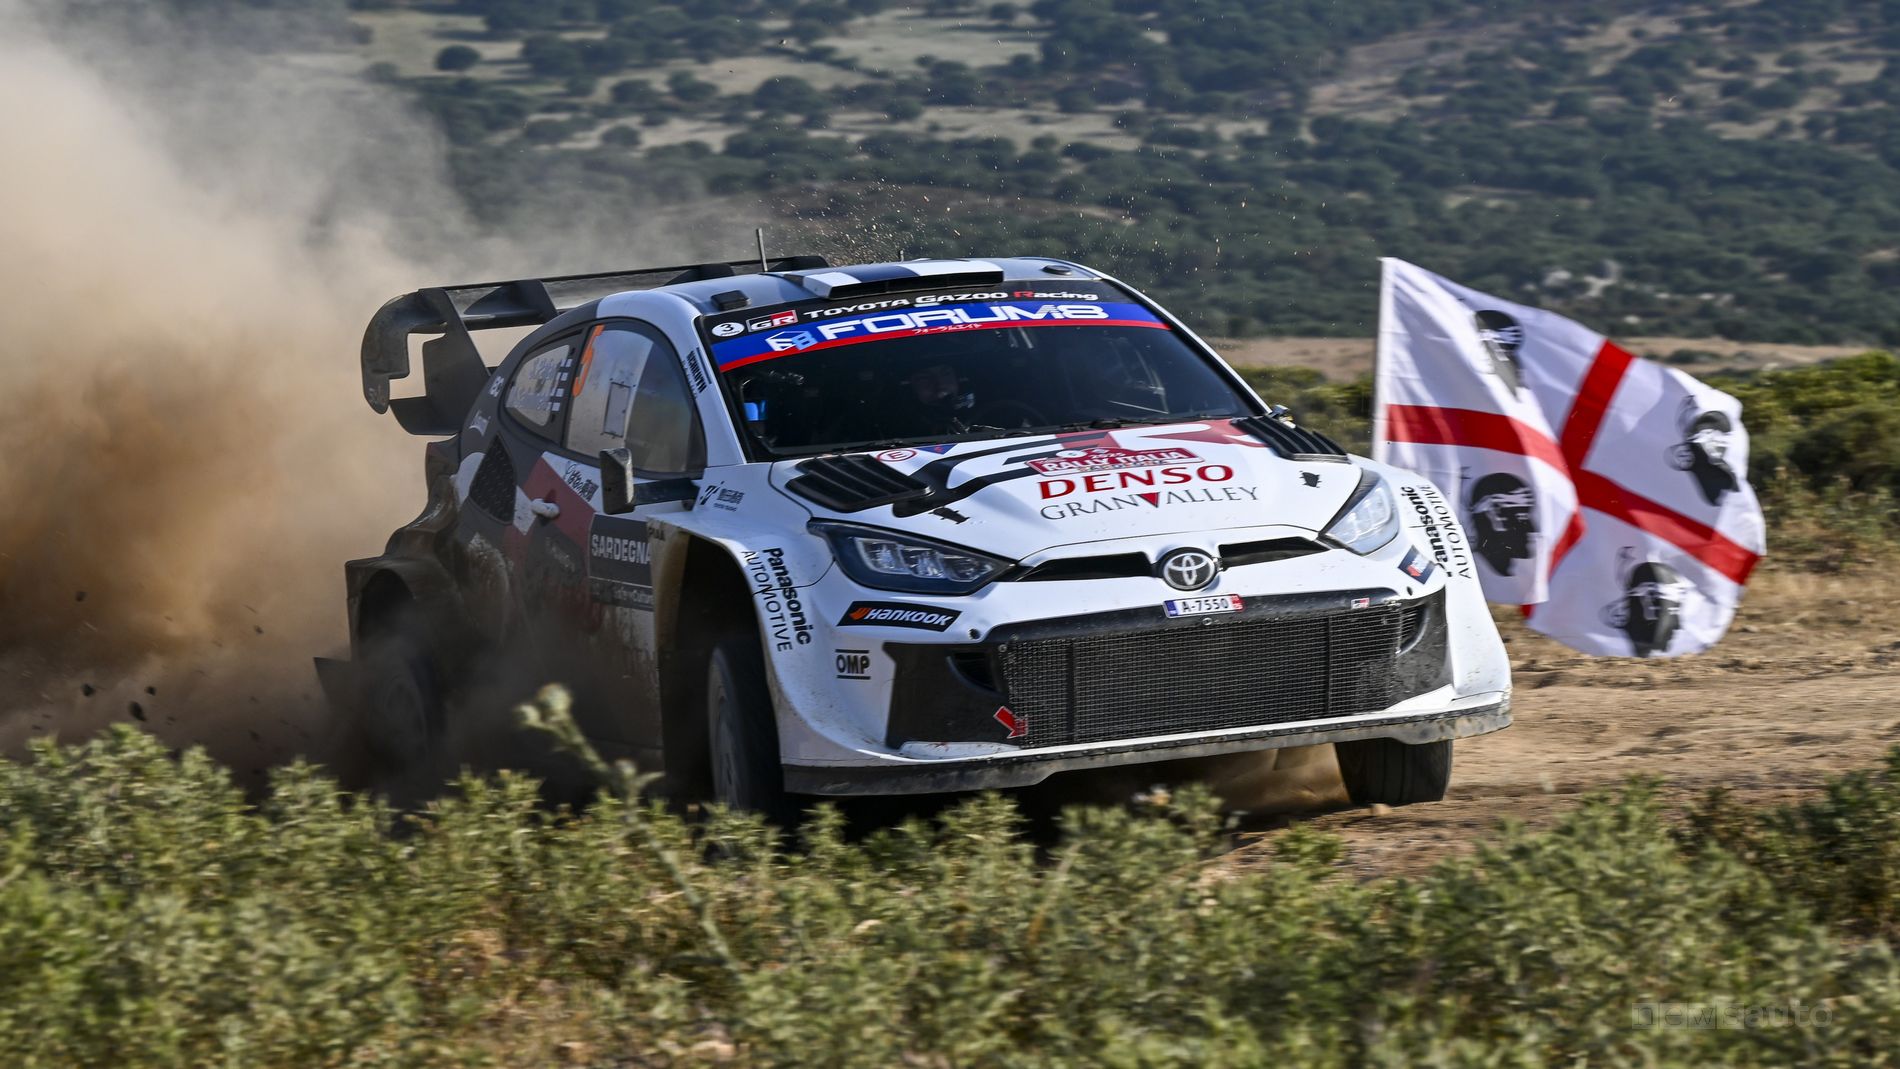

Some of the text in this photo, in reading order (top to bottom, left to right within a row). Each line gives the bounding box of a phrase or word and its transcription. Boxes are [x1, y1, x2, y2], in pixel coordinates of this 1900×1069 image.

[803, 291, 1099, 319] TOYOTA GAZOO Racing
[750, 314, 797, 331] GR
[817, 304, 1109, 340] FORUM8
[1043, 457, 1111, 472] RALLY
[1116, 451, 1187, 464] ITALIA
[1038, 463, 1234, 500] DENSO
[741, 551, 792, 652] AUTOMOTIVE
[763, 547, 814, 645] Panasonic
[1181, 598, 1229, 612] A-7550
[836, 654, 871, 675] OMP
